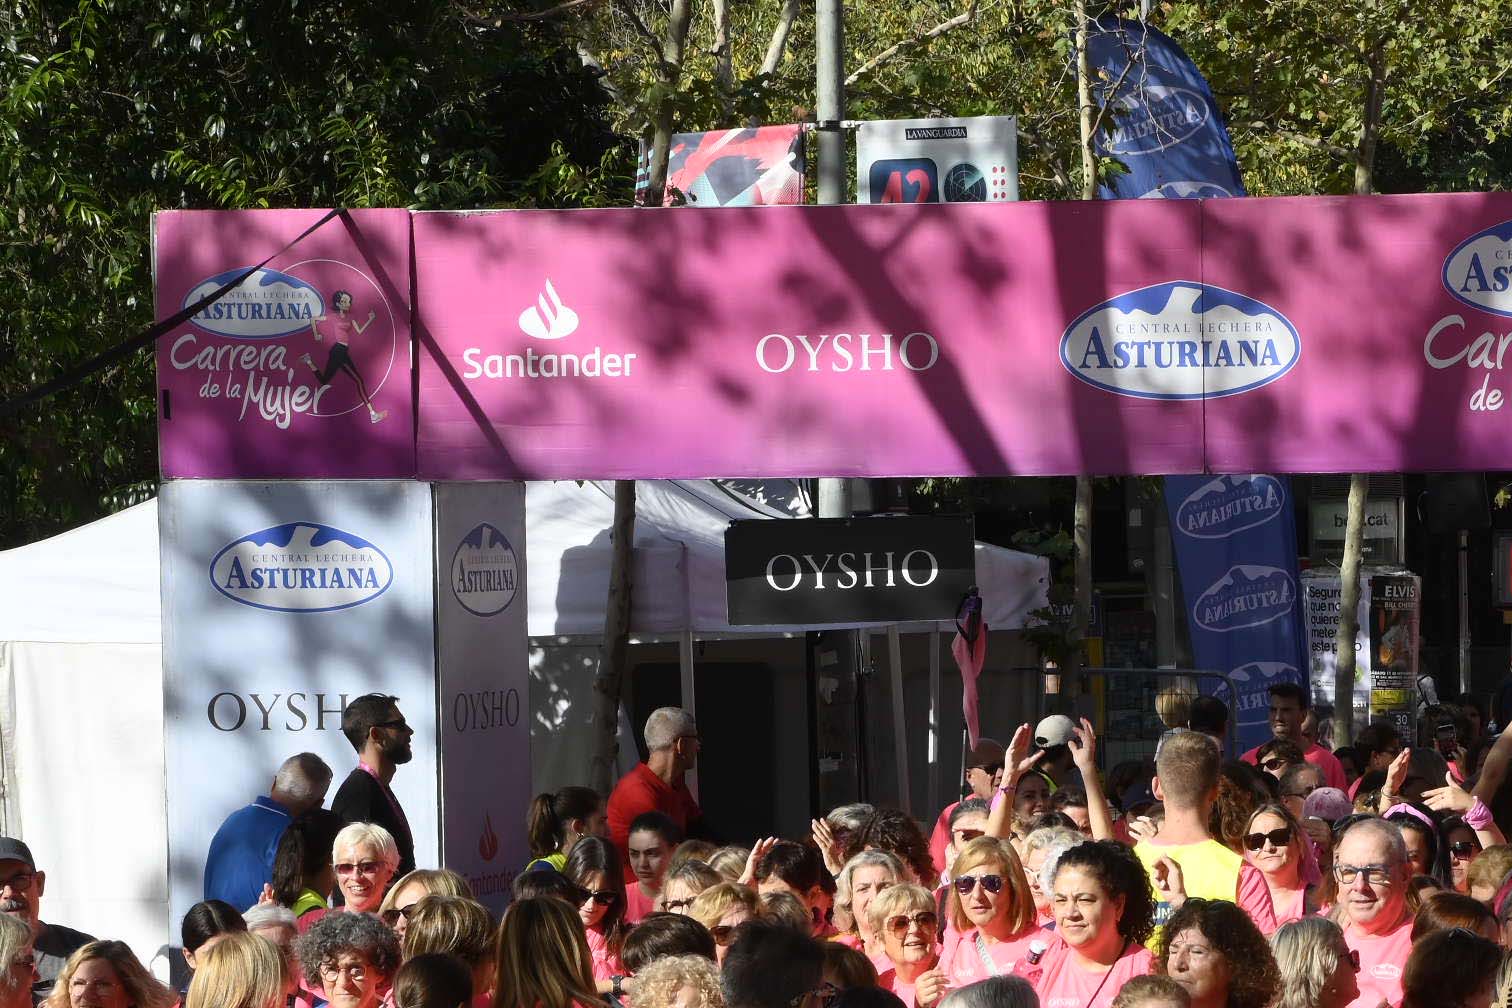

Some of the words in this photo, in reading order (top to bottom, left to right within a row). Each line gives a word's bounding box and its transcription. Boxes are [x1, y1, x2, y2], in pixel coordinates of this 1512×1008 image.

[193, 294, 312, 321] ASTURIANA
[263, 290, 309, 298] LECHERA
[1115, 323, 1192, 334] CENTRAL
[1199, 322, 1273, 333] LECHERA
[170, 334, 287, 371] Carrera
[463, 346, 636, 378] Santander
[755, 332, 939, 373] OYSHO
[1079, 326, 1282, 369] ASTURIANA
[200, 373, 221, 399] de
[226, 373, 241, 399] la
[239, 368, 332, 430] Mujer
[1469, 373, 1504, 412] de
[225, 555, 380, 591] ASTURIANA
[251, 553, 310, 562] CENTRAL
[315, 553, 374, 563] LECHERA
[456, 556, 515, 594] ASTURIANA
[766, 549, 939, 592] OYSHO
[1310, 601, 1327, 614] que
[1384, 584, 1415, 597] ELVIS
[1311, 641, 1329, 651] este
[207, 691, 347, 733] OYSH
[453, 687, 520, 734] OYSHO
